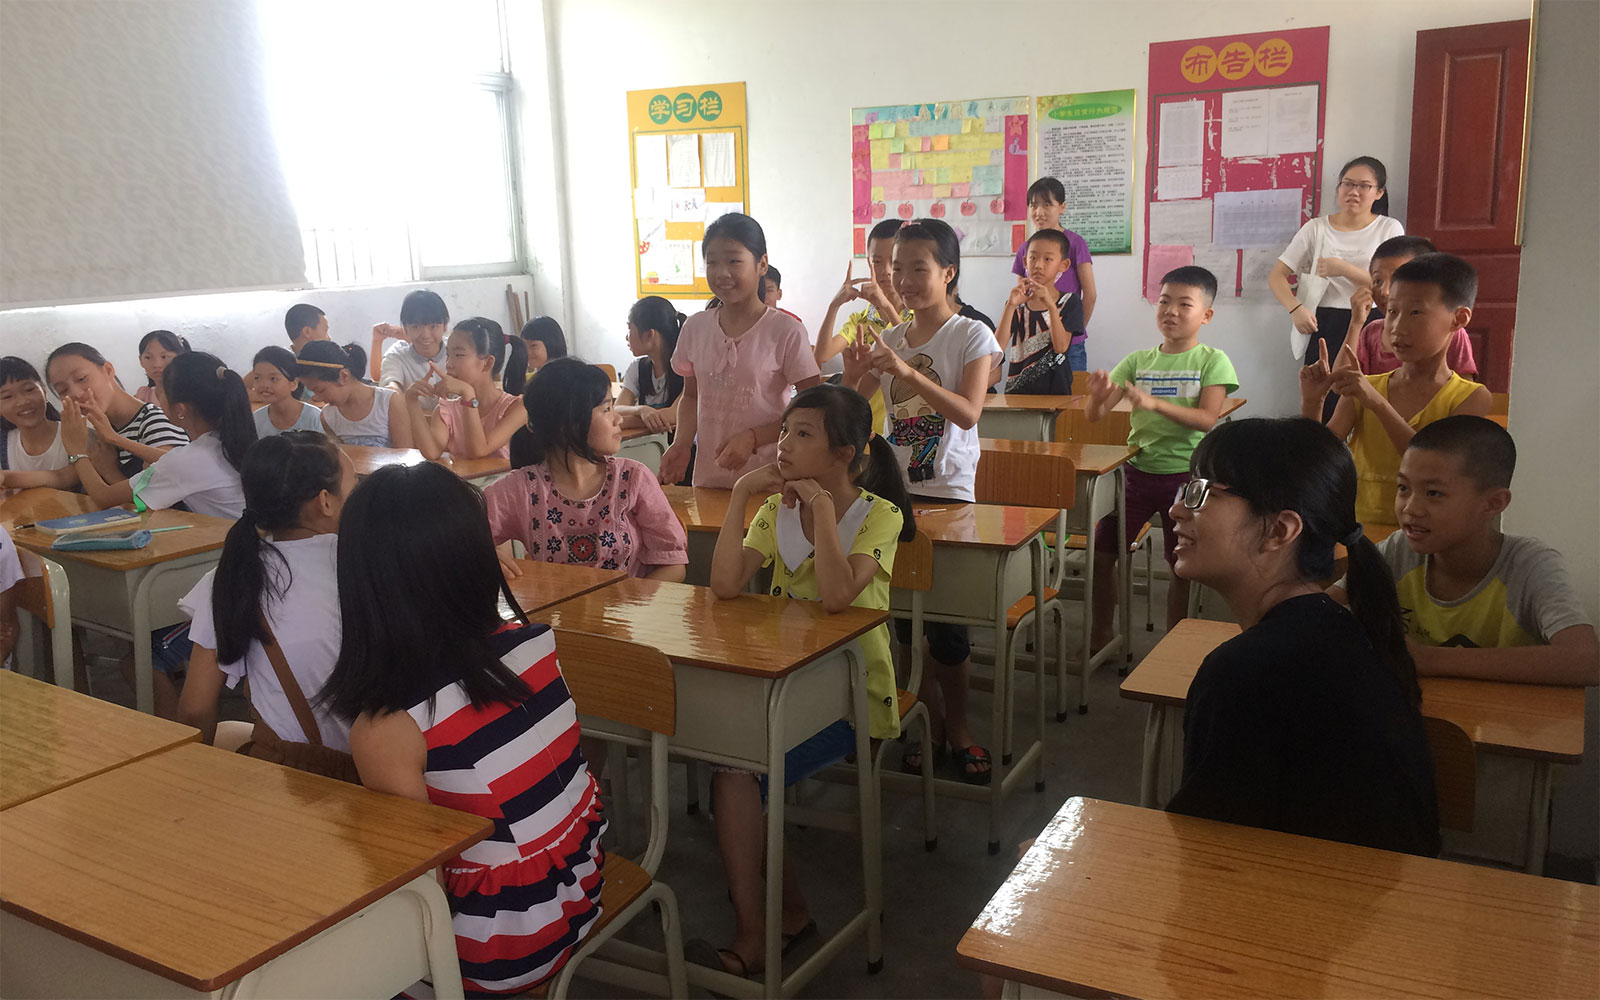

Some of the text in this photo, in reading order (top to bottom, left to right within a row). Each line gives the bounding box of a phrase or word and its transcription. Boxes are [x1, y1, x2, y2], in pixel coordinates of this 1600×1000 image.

[1185, 46, 1288, 76] 布告栏
[651, 97, 720, 119] 学习栏
